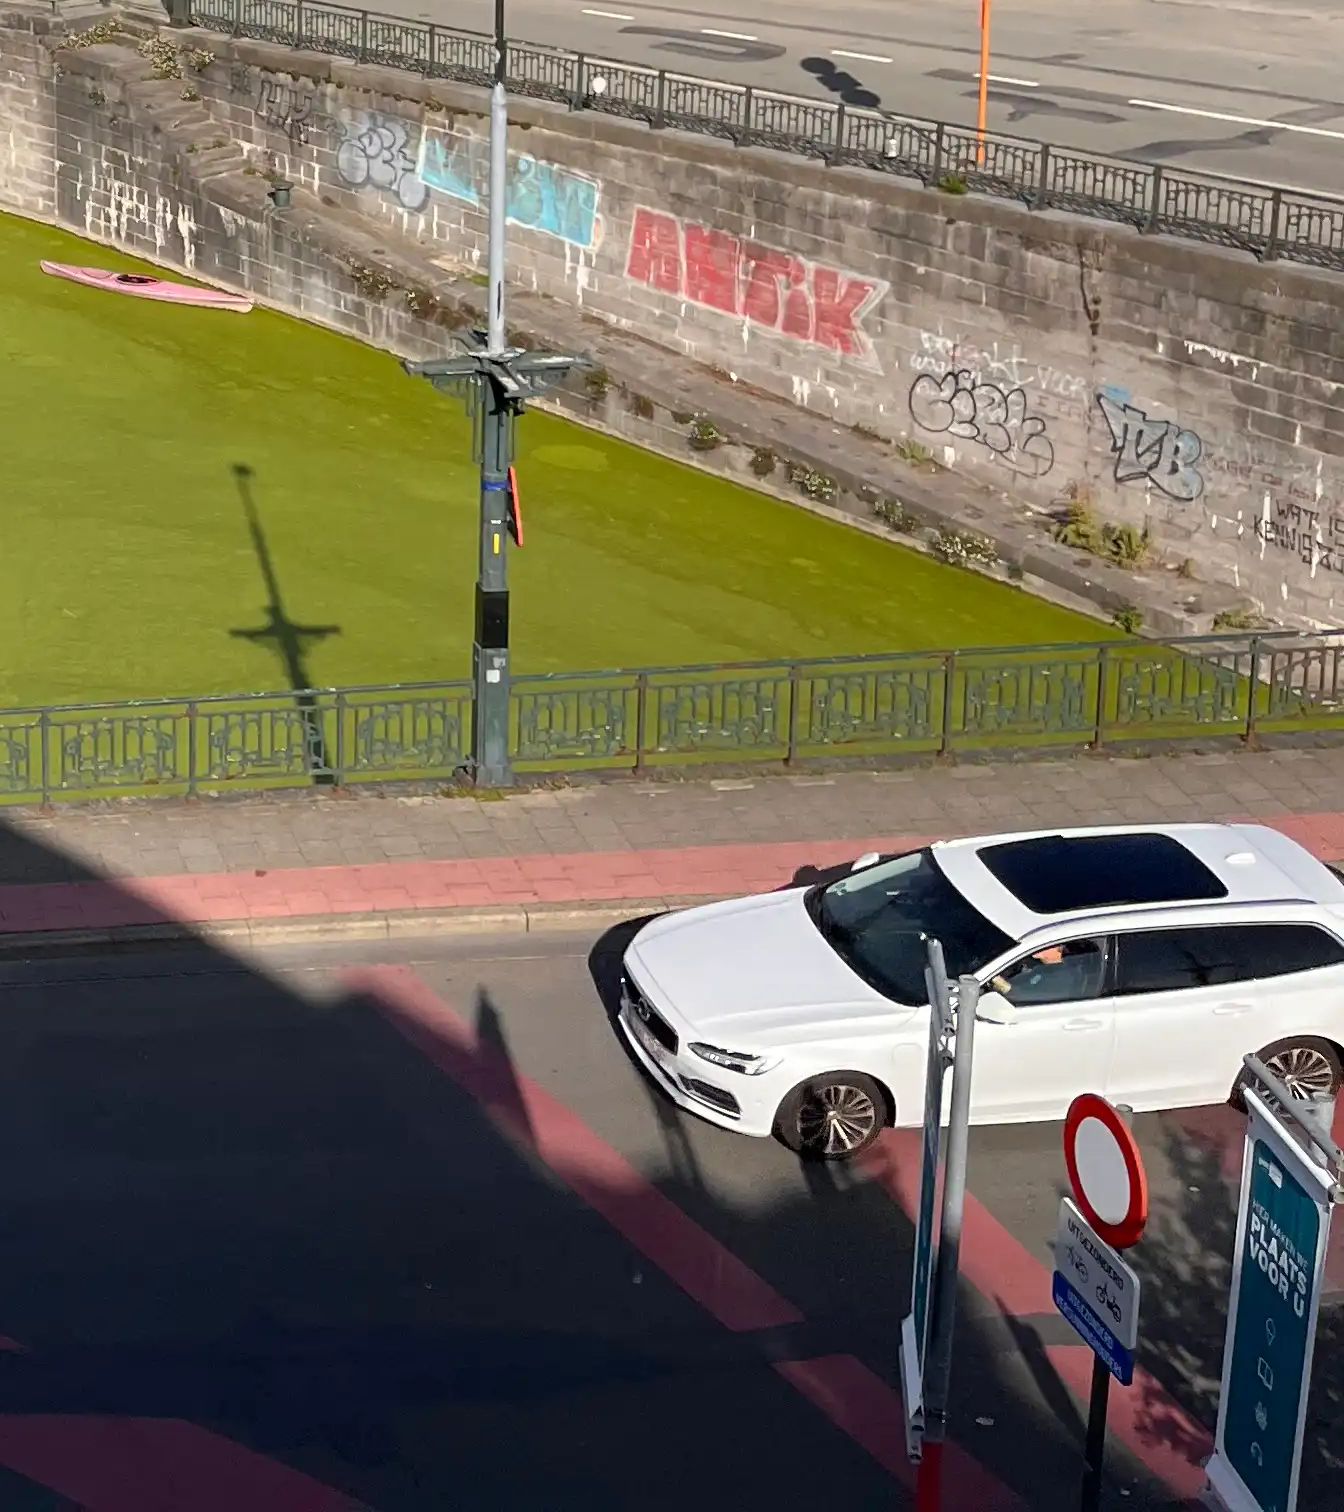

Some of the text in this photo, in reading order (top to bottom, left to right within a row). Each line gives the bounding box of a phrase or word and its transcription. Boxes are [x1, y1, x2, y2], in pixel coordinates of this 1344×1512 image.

[1068, 1217, 1124, 1291] UITGEZONDERD
[1249, 1234, 1305, 1319] VOOR U
[1251, 1212, 1308, 1296] PLAATS
